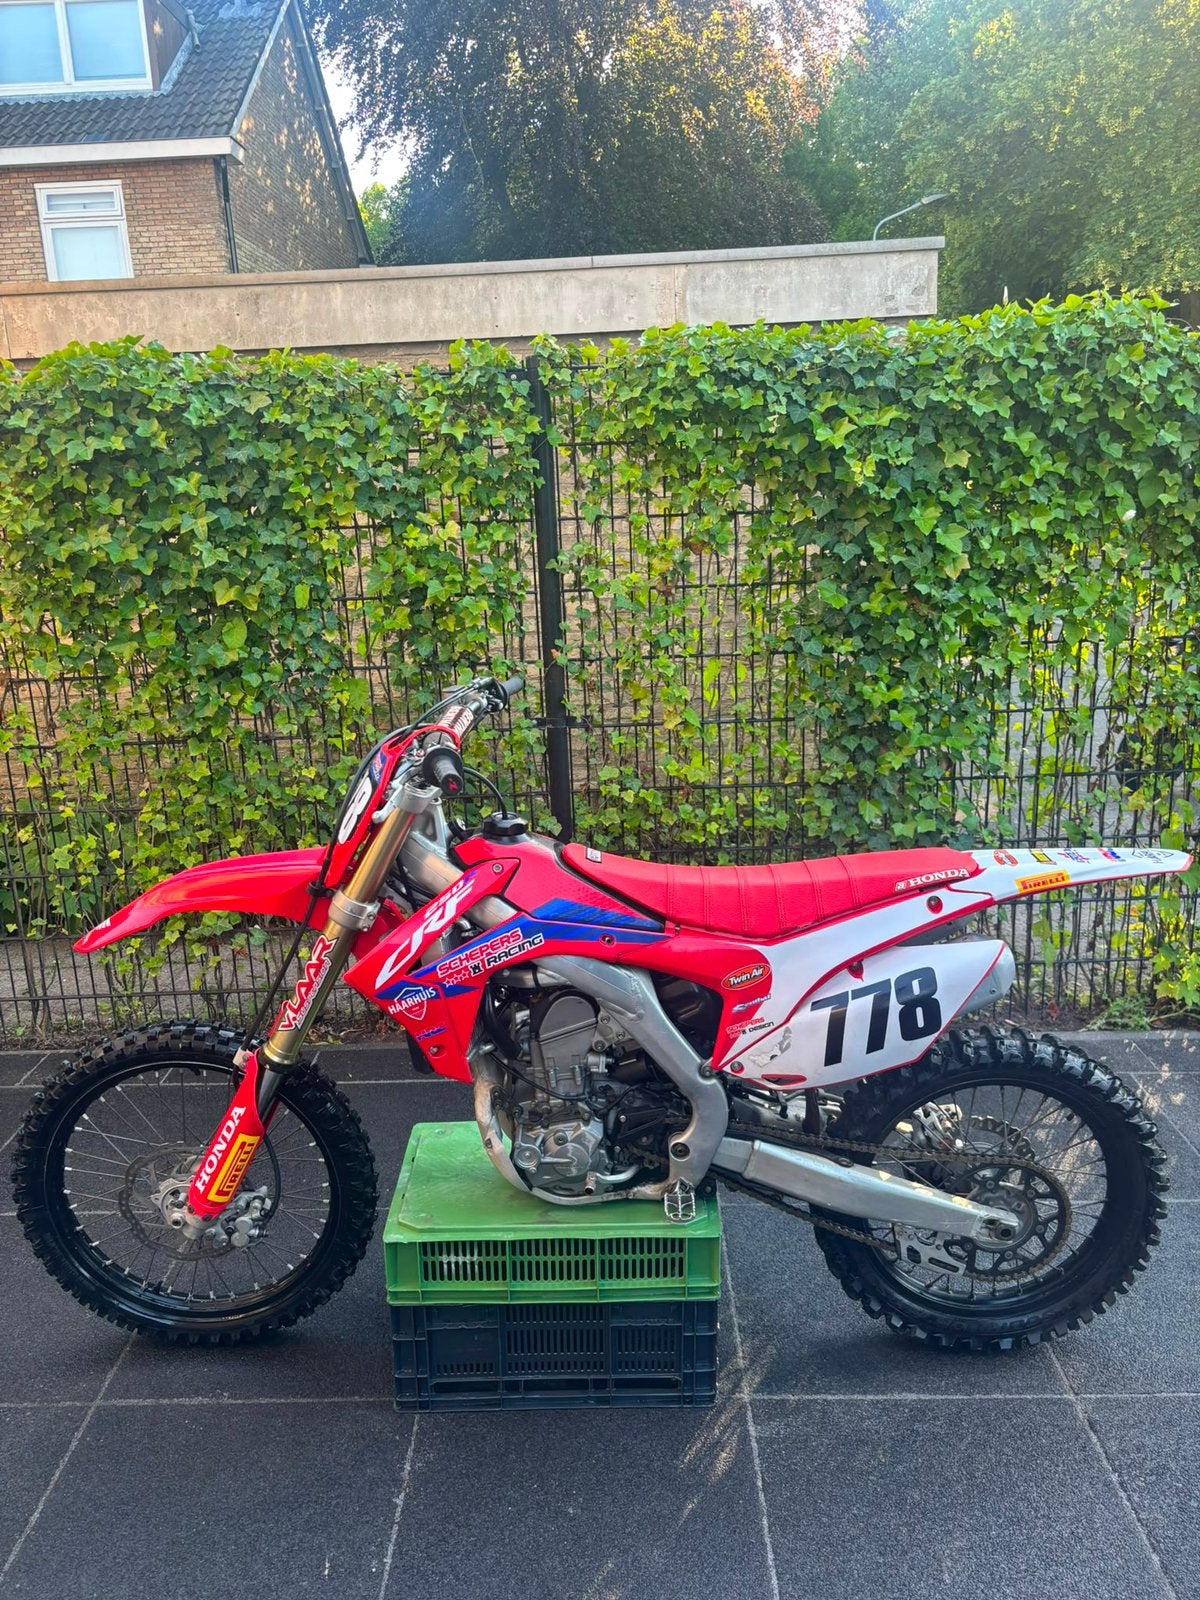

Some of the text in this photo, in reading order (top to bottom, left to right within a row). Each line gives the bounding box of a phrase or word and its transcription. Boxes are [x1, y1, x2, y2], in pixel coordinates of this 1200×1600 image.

[909, 868, 970, 887] HONDA
[1020, 872, 1066, 890] PIRELLI
[375, 879, 476, 990] CRF
[438, 928, 522, 976] SCHEPERS
[486, 934, 544, 968] RACING
[729, 966, 765, 987] Twin Air
[388, 987, 436, 1014] HAARHUIS
[810, 966, 942, 1067] 778
[195, 1106, 246, 1194] HONDA
[214, 1141, 255, 1197] PIRELLI
